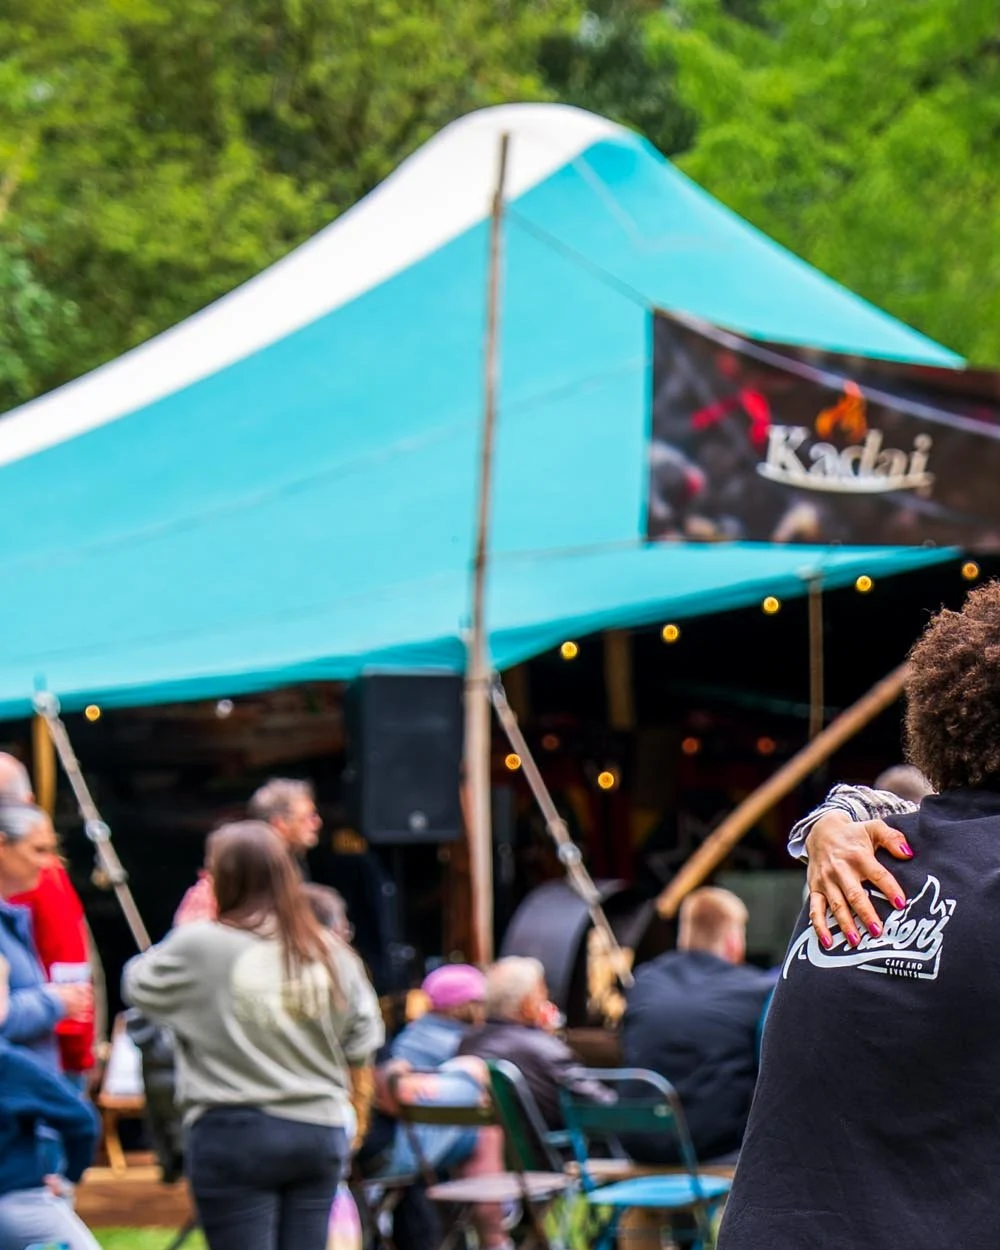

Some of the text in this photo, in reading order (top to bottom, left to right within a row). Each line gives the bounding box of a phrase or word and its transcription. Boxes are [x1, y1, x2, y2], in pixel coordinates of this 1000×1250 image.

[764, 424, 934, 492] Kadai
[885, 958, 923, 970] CAFE AND
[889, 967, 918, 978] EVENTS
